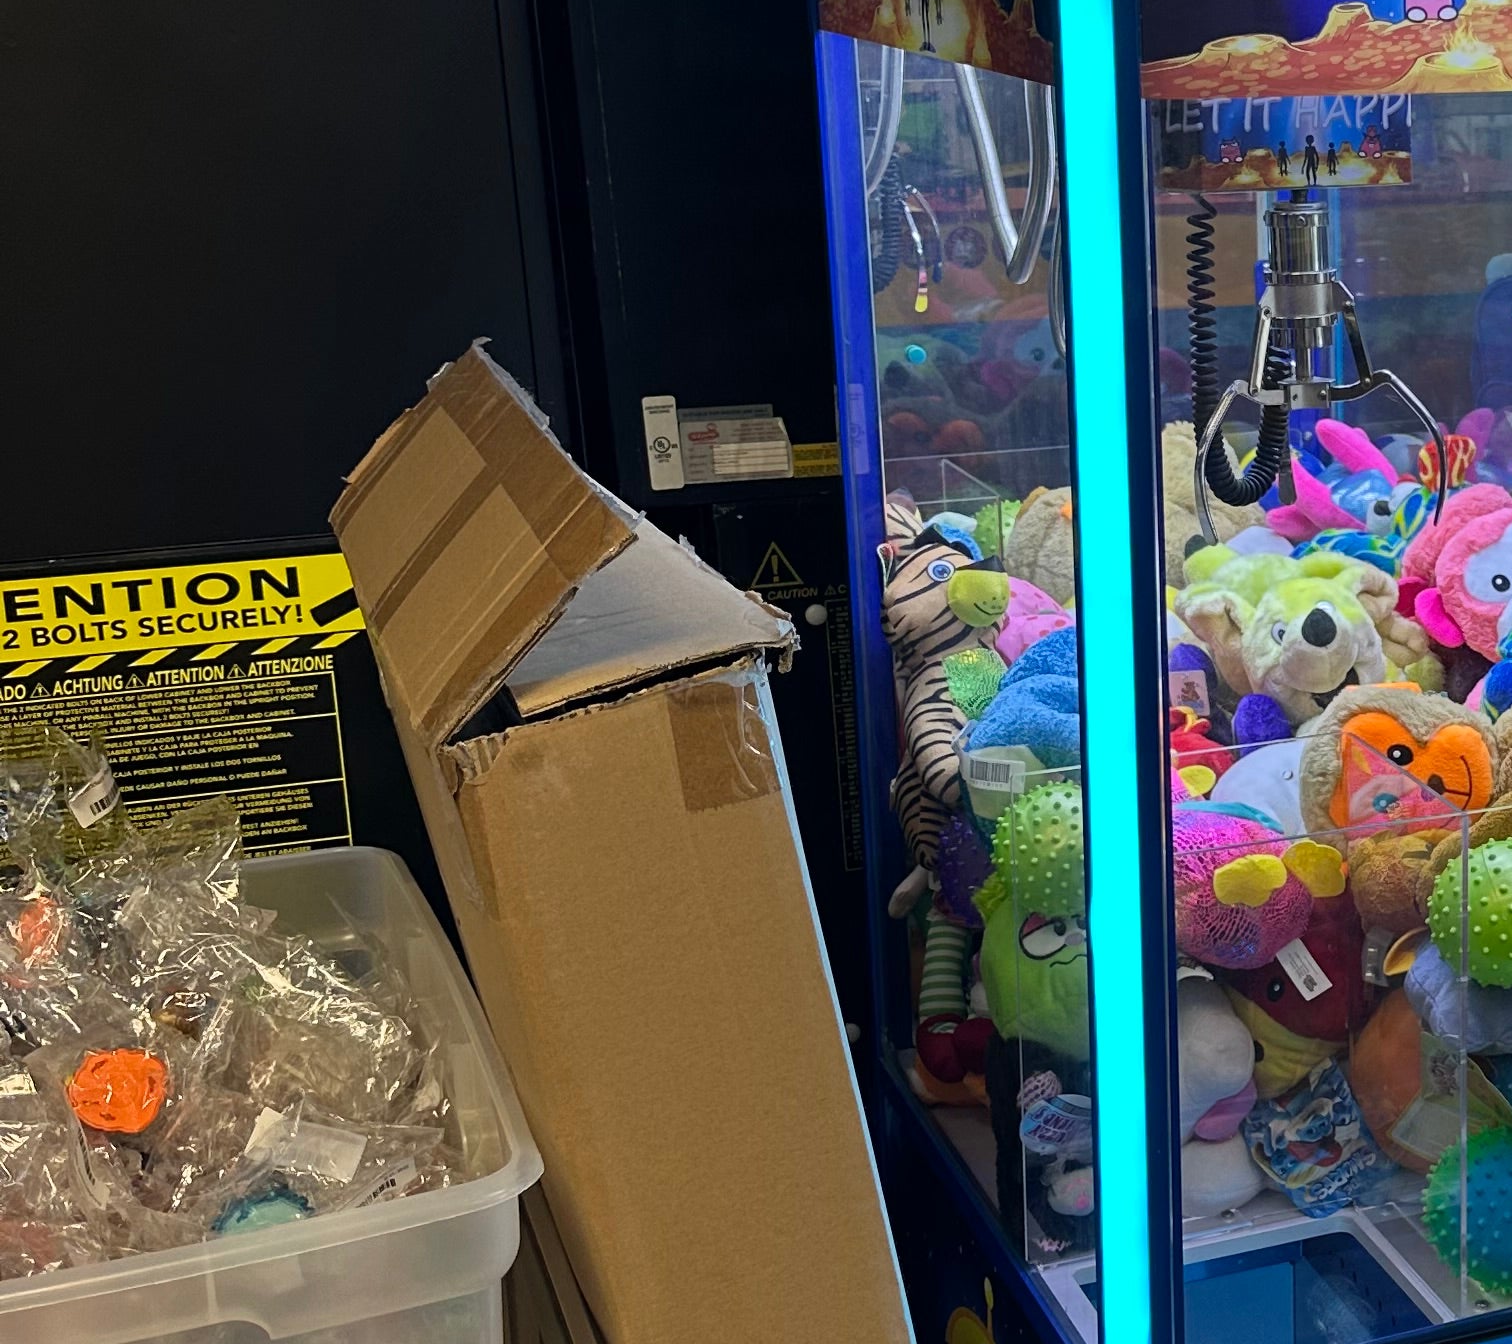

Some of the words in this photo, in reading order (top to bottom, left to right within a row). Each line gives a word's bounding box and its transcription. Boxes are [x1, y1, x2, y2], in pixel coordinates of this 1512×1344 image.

[1165, 96, 1232, 134] LET
[1243, 95, 1283, 133] IT
[1294, 93, 1413, 131] HAPP
[767, 586, 819, 602] CAUTION
[2, 628, 22, 651] 2
[32, 618, 128, 648] BOLTS
[138, 602, 305, 639] SECURELY!
[52, 675, 124, 697] ACHTUNG
[146, 664, 225, 687] ATTENTION
[247, 654, 335, 677] ATTENZIONE
